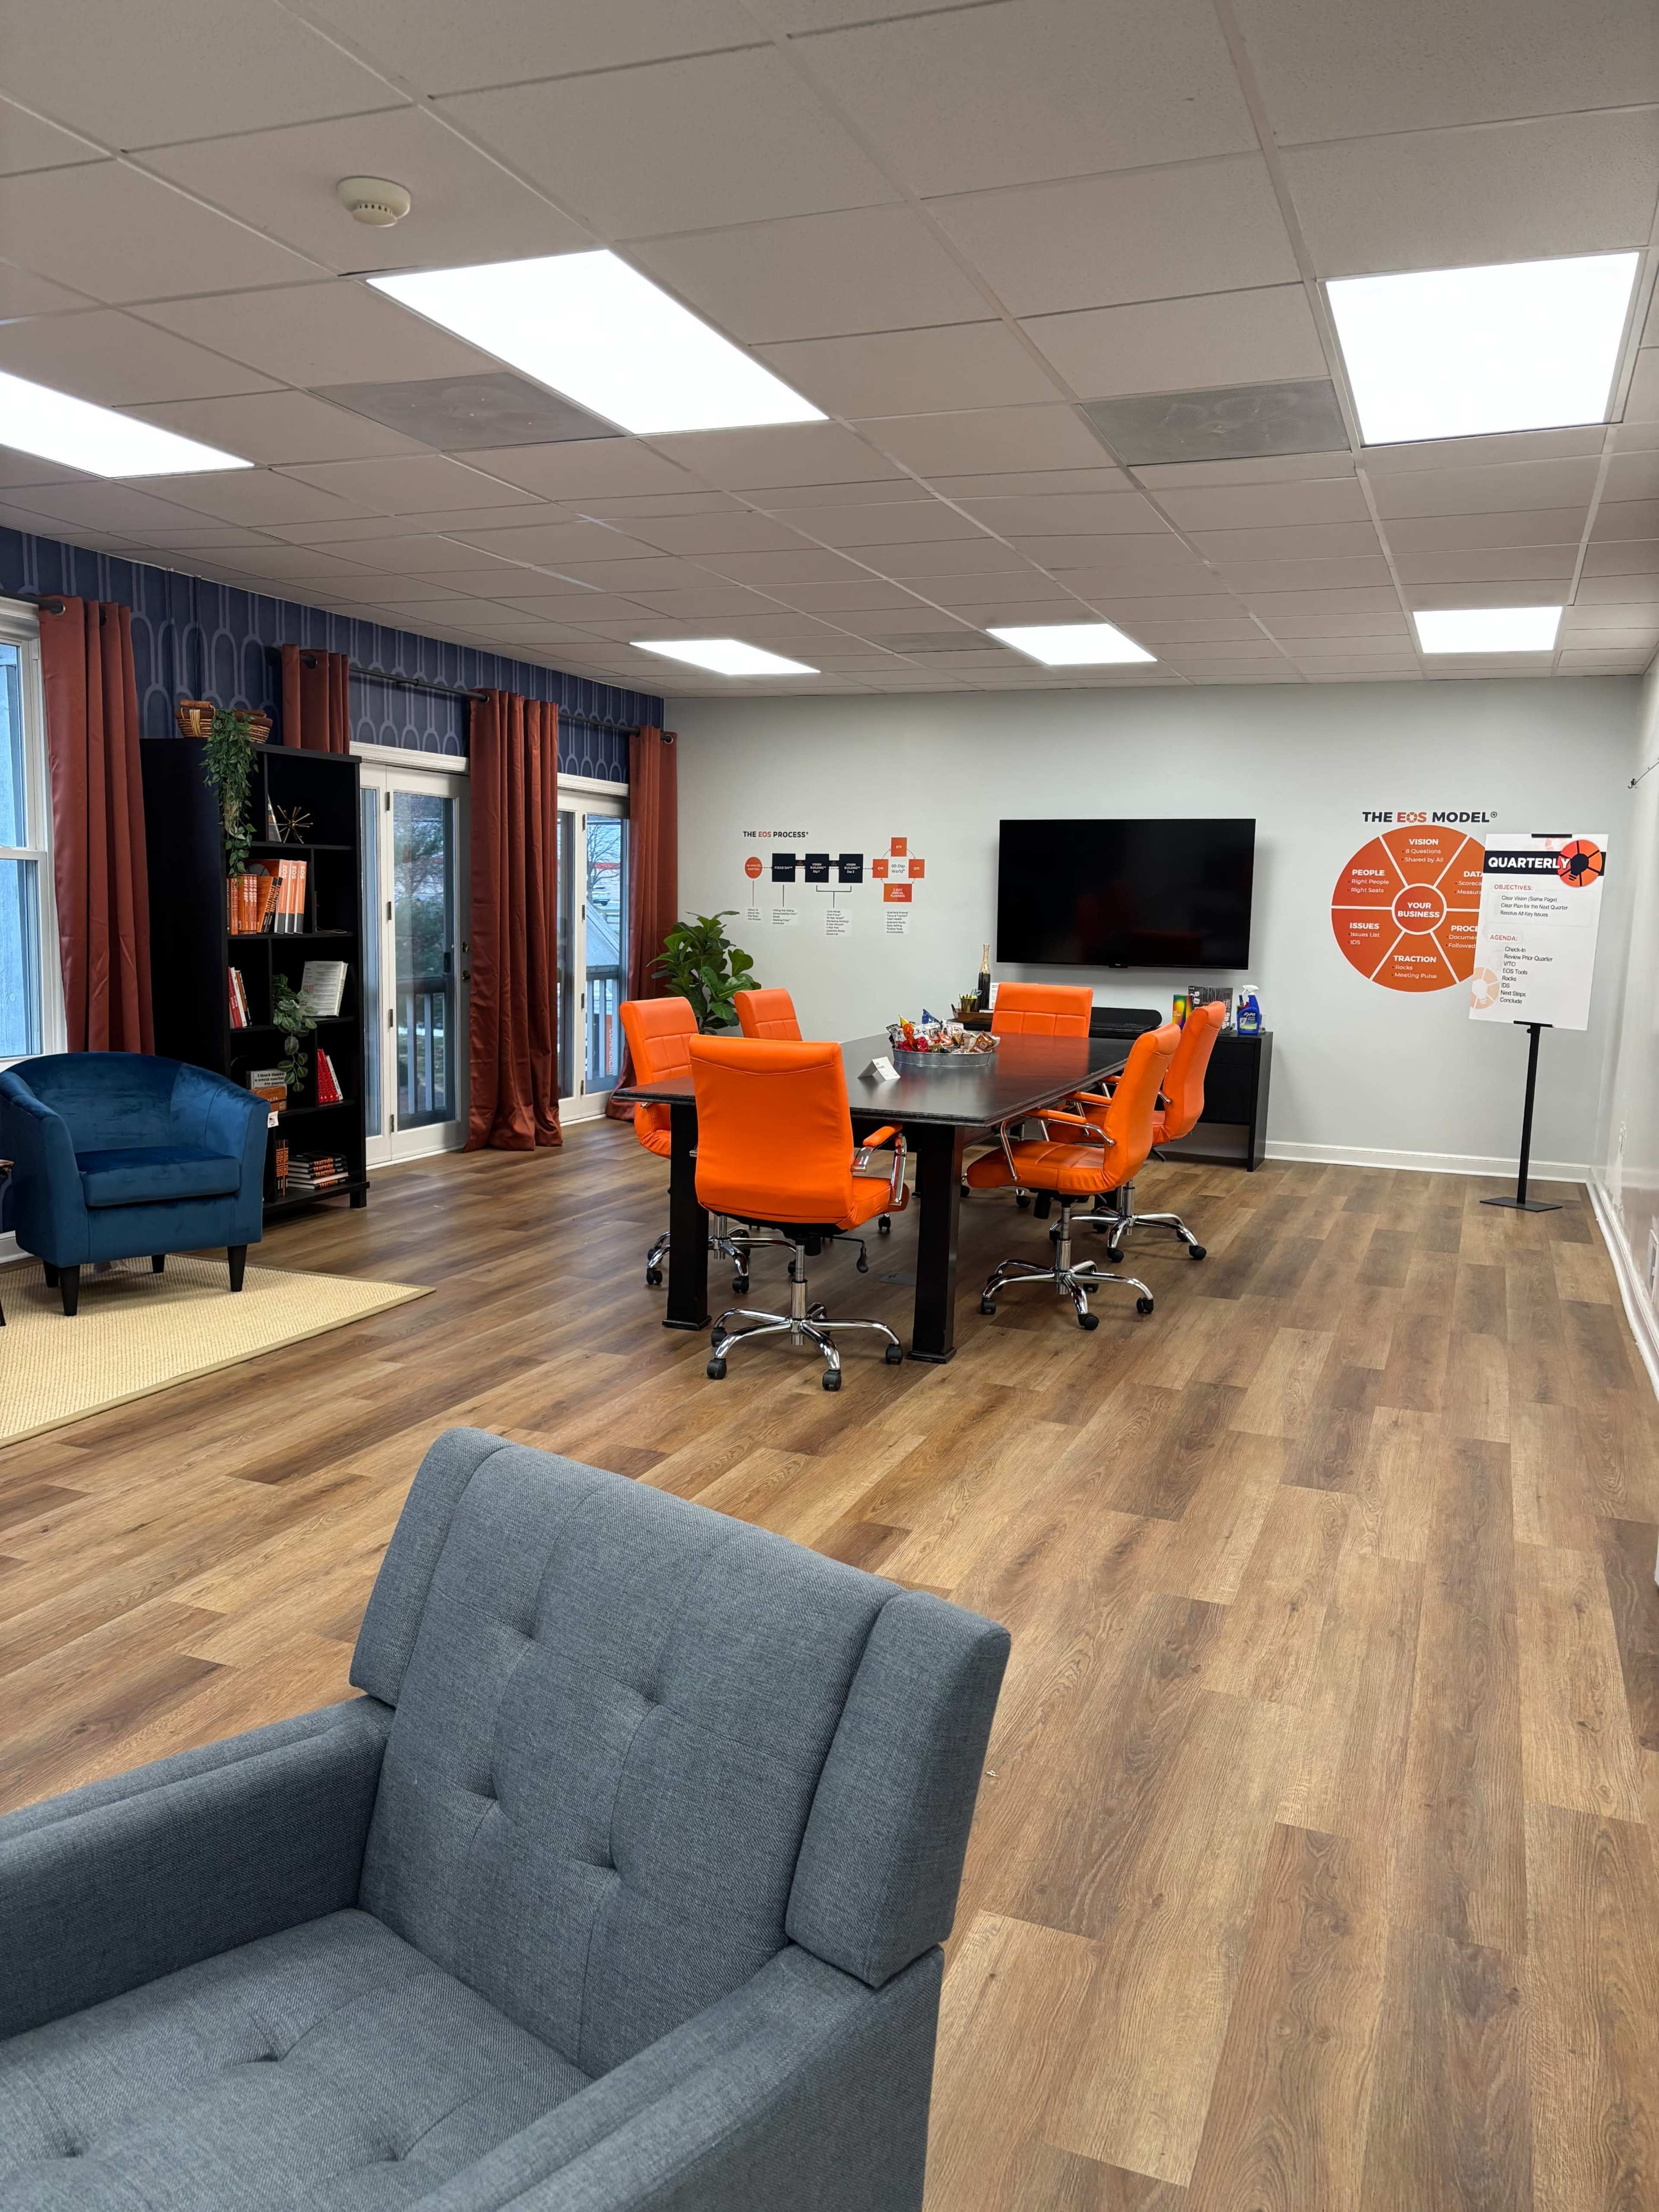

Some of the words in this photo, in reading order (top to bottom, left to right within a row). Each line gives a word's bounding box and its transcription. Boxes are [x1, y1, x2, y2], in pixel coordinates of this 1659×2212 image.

[1362, 812, 1393, 823] THE
[1397, 811, 1427, 823] EOS
[1488, 857, 1570, 869] QUARTERLY
[1393, 955, 1437, 963] TRACTION
[314, 1157, 334, 1166] TRACTION
[313, 1163, 334, 1171] TRACTION
[319, 1180, 338, 1188] TRACTION
